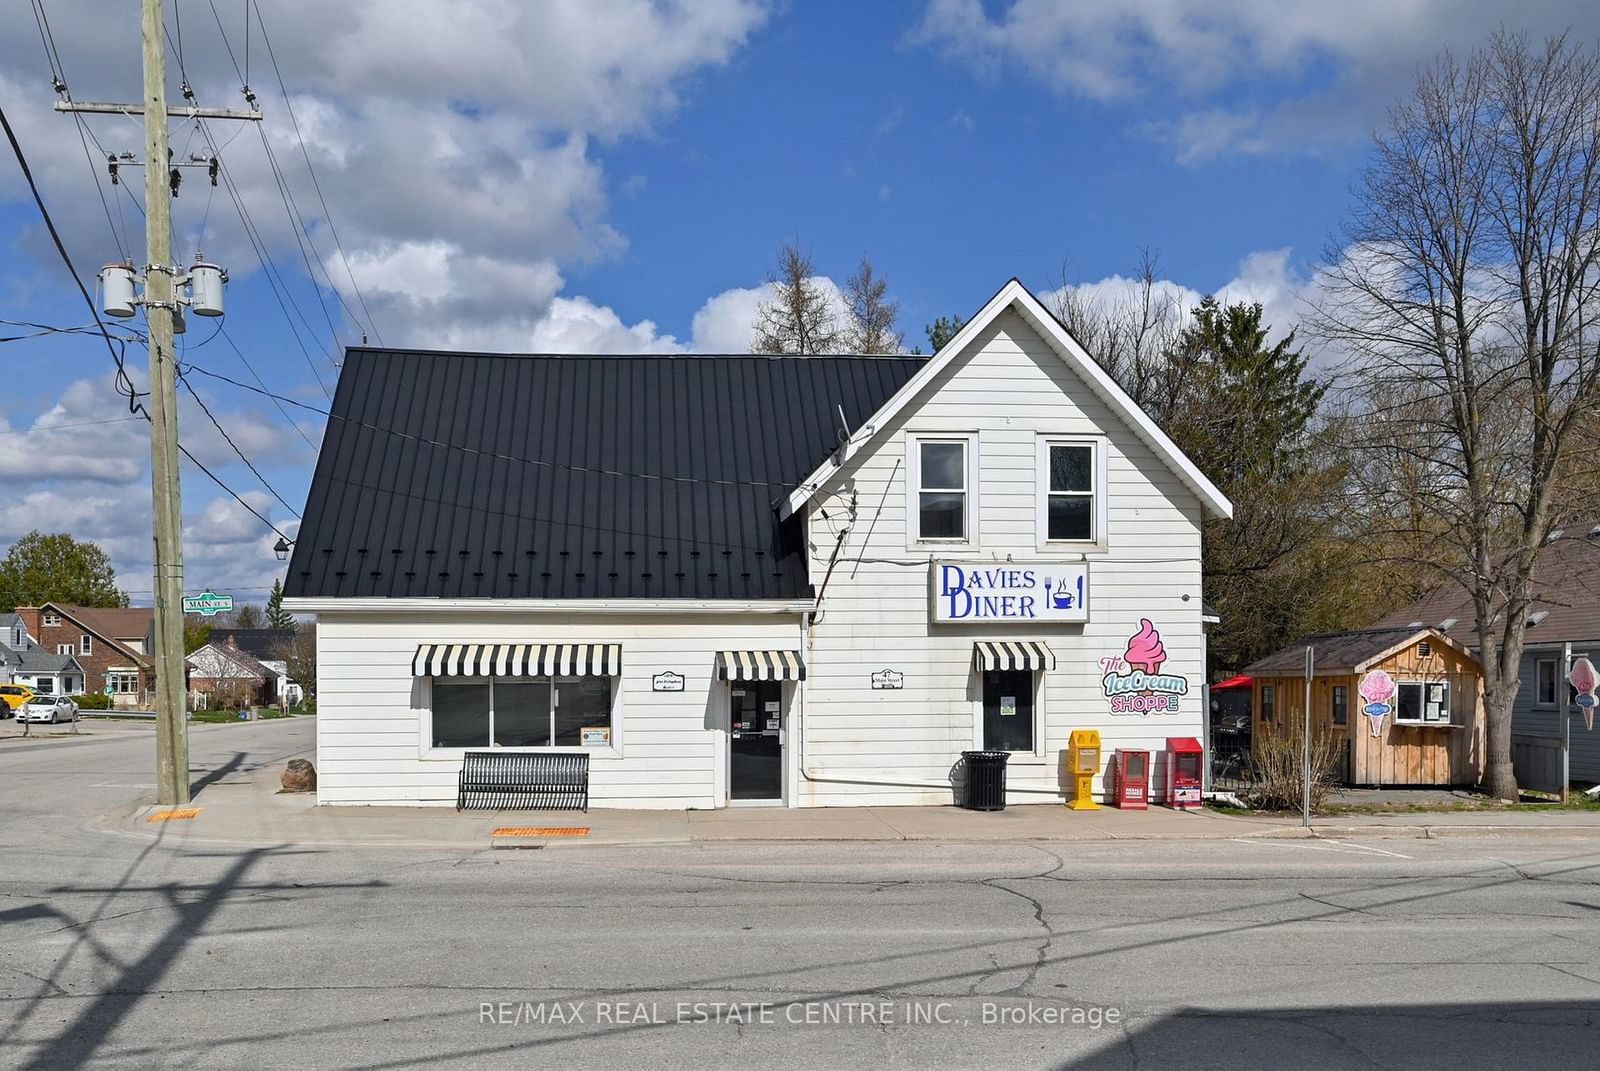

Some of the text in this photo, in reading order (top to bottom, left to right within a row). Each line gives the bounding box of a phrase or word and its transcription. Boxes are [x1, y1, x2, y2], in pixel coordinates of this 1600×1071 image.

[940, 565, 1036, 597] DAVIES
[189, 600, 212, 608] MAIN
[948, 587, 1035, 618] DINER
[1100, 656, 1126, 674] The
[1111, 695, 1179, 712] SHOPPE
